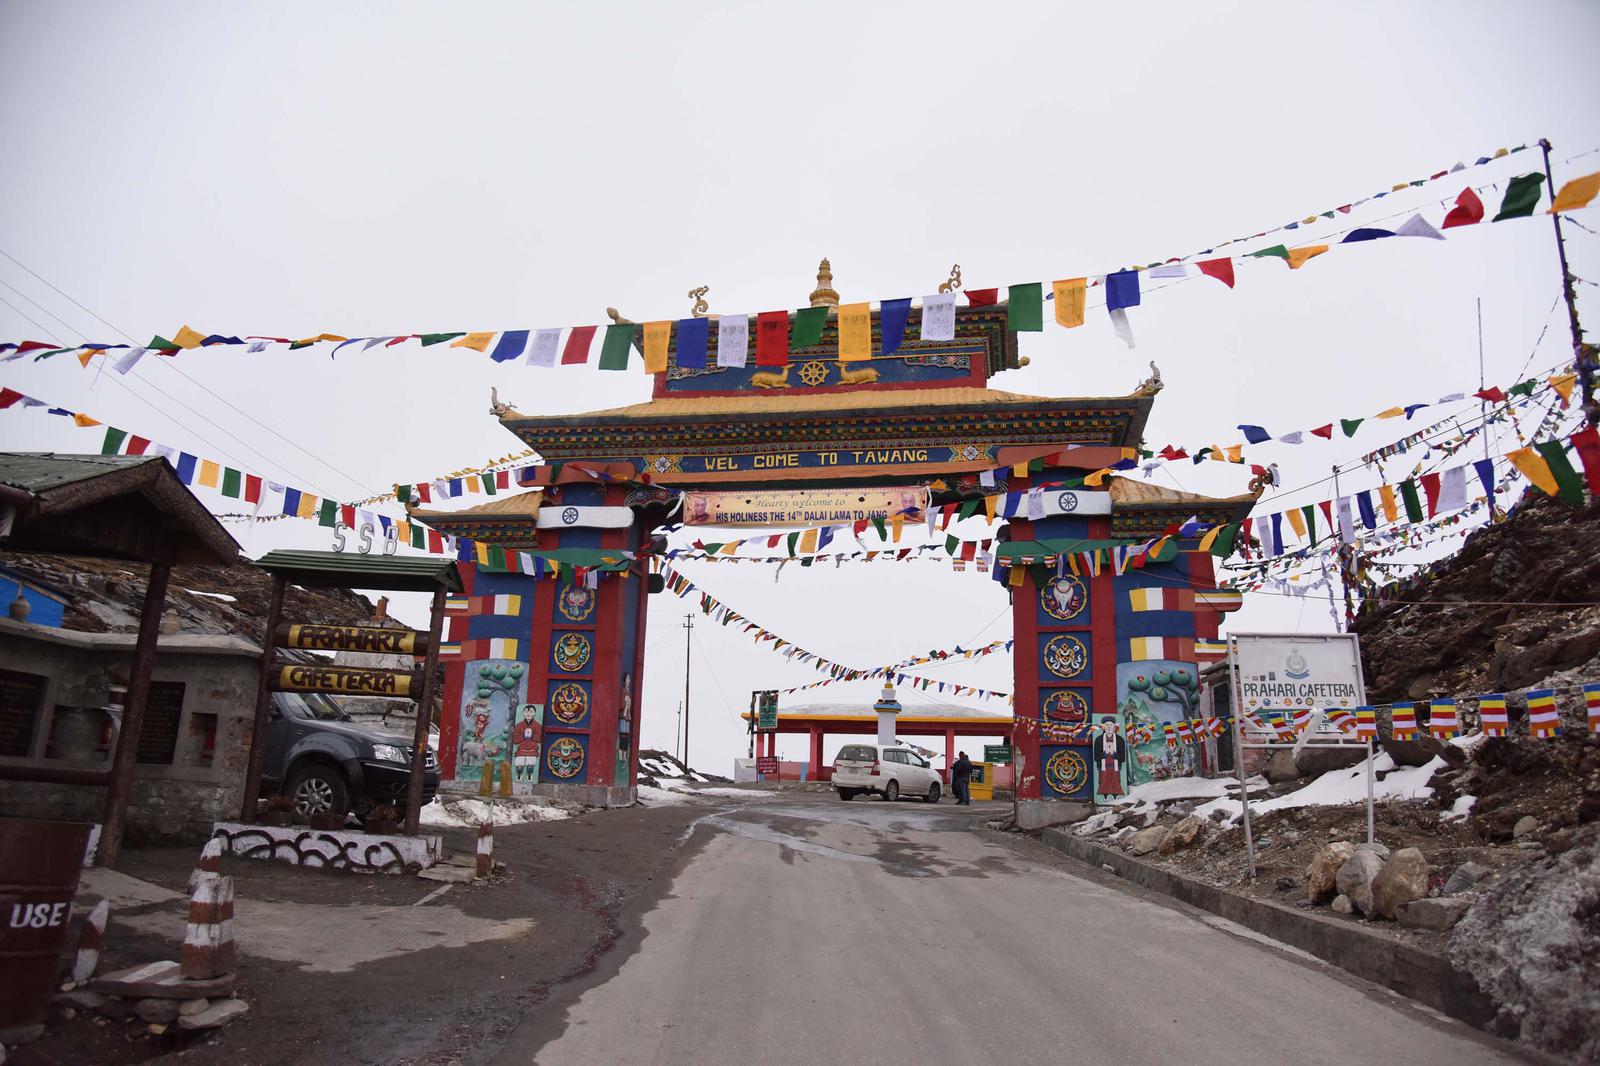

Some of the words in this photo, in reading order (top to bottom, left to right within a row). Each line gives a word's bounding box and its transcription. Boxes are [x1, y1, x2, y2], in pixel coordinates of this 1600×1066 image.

[705, 457, 738, 471] WEL
[753, 452, 800, 468] COME
[816, 452, 838, 466] TO
[854, 449, 929, 463] TAWANG
[755, 499, 790, 508] Hearty
[792, 498, 832, 507] welcome
[715, 512, 729, 523] HIS
[730, 511, 768, 522] HOLINESS
[769, 511, 785, 521] THE
[804, 510, 827, 521] DALAI
[829, 510, 850, 520] LAMA
[853, 510, 864, 520] TO
[865, 510, 888, 520] JANG
[297, 626, 408, 652] PRAHARI
[289, 667, 396, 693] CAFETERIA
[1243, 683, 1296, 697] PRAHARI
[1299, 683, 1356, 697] CAFETERIA
[10, 903, 67, 928] USE
